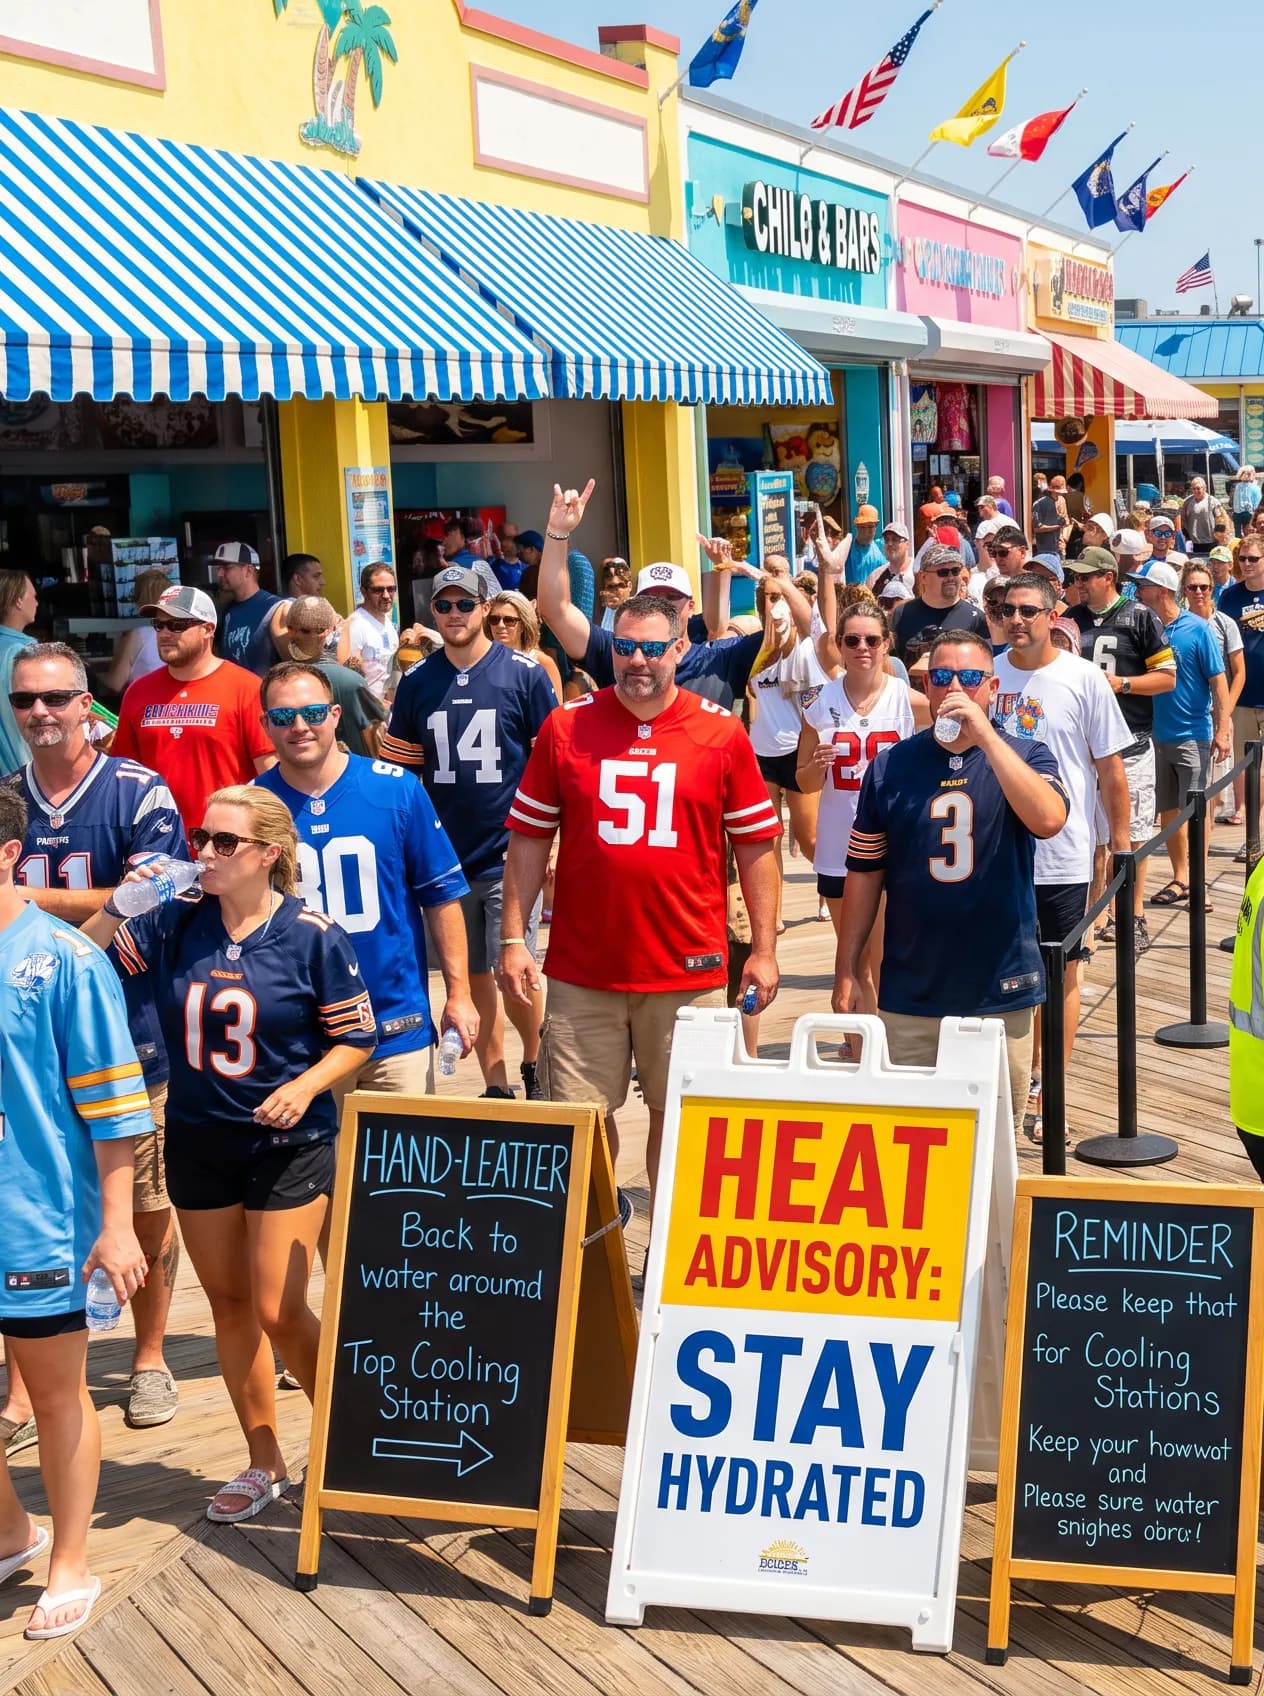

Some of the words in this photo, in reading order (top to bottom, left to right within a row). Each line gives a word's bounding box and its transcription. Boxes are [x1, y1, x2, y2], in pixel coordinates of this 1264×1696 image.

[818, 199, 832, 265] &
[835, 203, 881, 275] BARS
[426, 708, 503, 784] 14
[598, 759, 678, 848] 51
[928, 790, 974, 884] 3
[185, 981, 258, 1079] 13
[362, 1127, 569, 1194] HAND-LEATTER
[698, 1116, 949, 1230] HEAT
[401, 1211, 474, 1251] Back
[489, 1221, 518, 1254] to
[1055, 1210, 1234, 1269] REMINDER
[360, 1257, 438, 1290] water
[683, 1233, 942, 1301] ADVISORY:
[418, 1300, 465, 1330] the
[1036, 1281, 1108, 1312] Please
[1122, 1287, 1174, 1325] keep
[1185, 1291, 1238, 1318] that
[343, 1339, 396, 1387] Top
[411, 1340, 520, 1405] Cooling
[1033, 1332, 1071, 1364] for
[1085, 1331, 1190, 1387] Cooling
[379, 1383, 489, 1426] Station
[670, 1330, 935, 1452] STAY
[1093, 1374, 1220, 1416] Stations
[1029, 1423, 1080, 1462] Keep
[1089, 1437, 1139, 1465] your
[1108, 1463, 1147, 1484] and
[657, 1452, 925, 1528] HYDRATED
[1024, 1484, 1086, 1509] Please
[1098, 1493, 1143, 1512] sure
[1155, 1492, 1220, 1515] water
[1058, 1519, 1132, 1546] snighes
